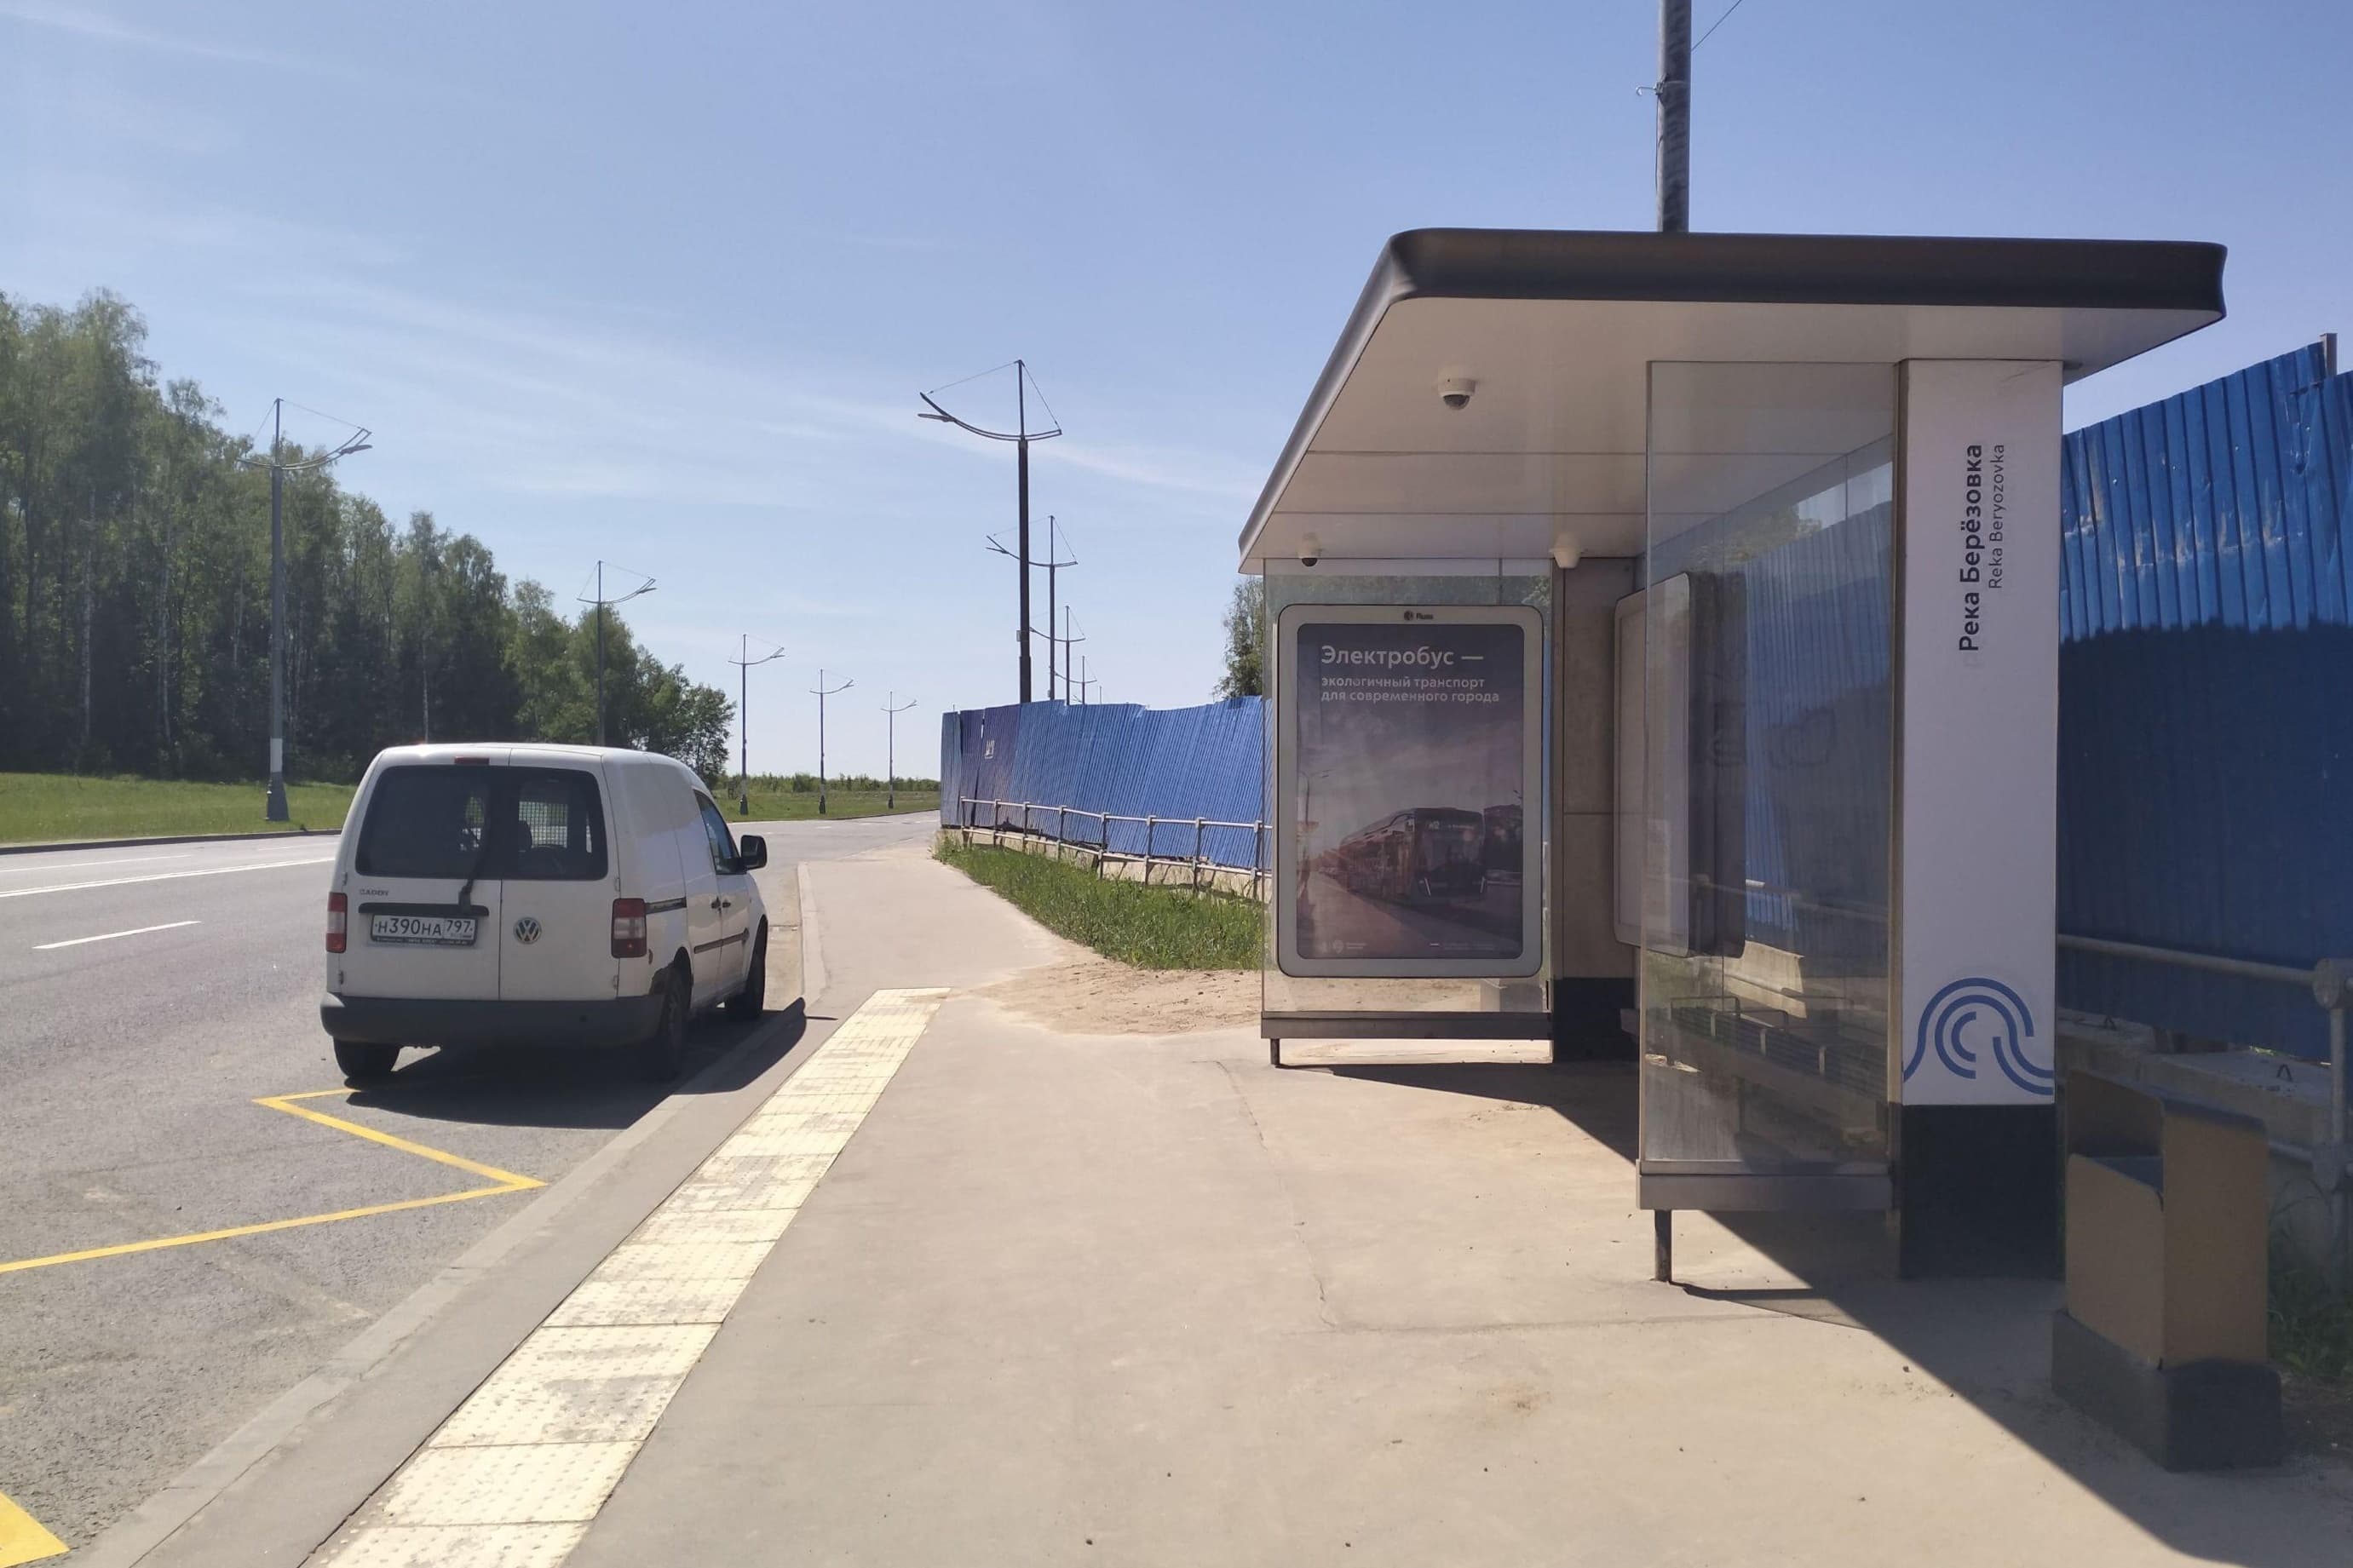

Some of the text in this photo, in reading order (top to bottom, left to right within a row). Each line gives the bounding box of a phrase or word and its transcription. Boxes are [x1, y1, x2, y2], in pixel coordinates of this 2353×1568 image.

[1988, 445, 2007, 589] Reka Beryozovka
[1959, 445, 1985, 652] Река Берёзовка
[1321, 646, 1454, 669] Электробус
[1321, 675, 1485, 691] экологичный транспорт
[1321, 691, 1499, 704] для современного города
[446, 920, 471, 933] 797
